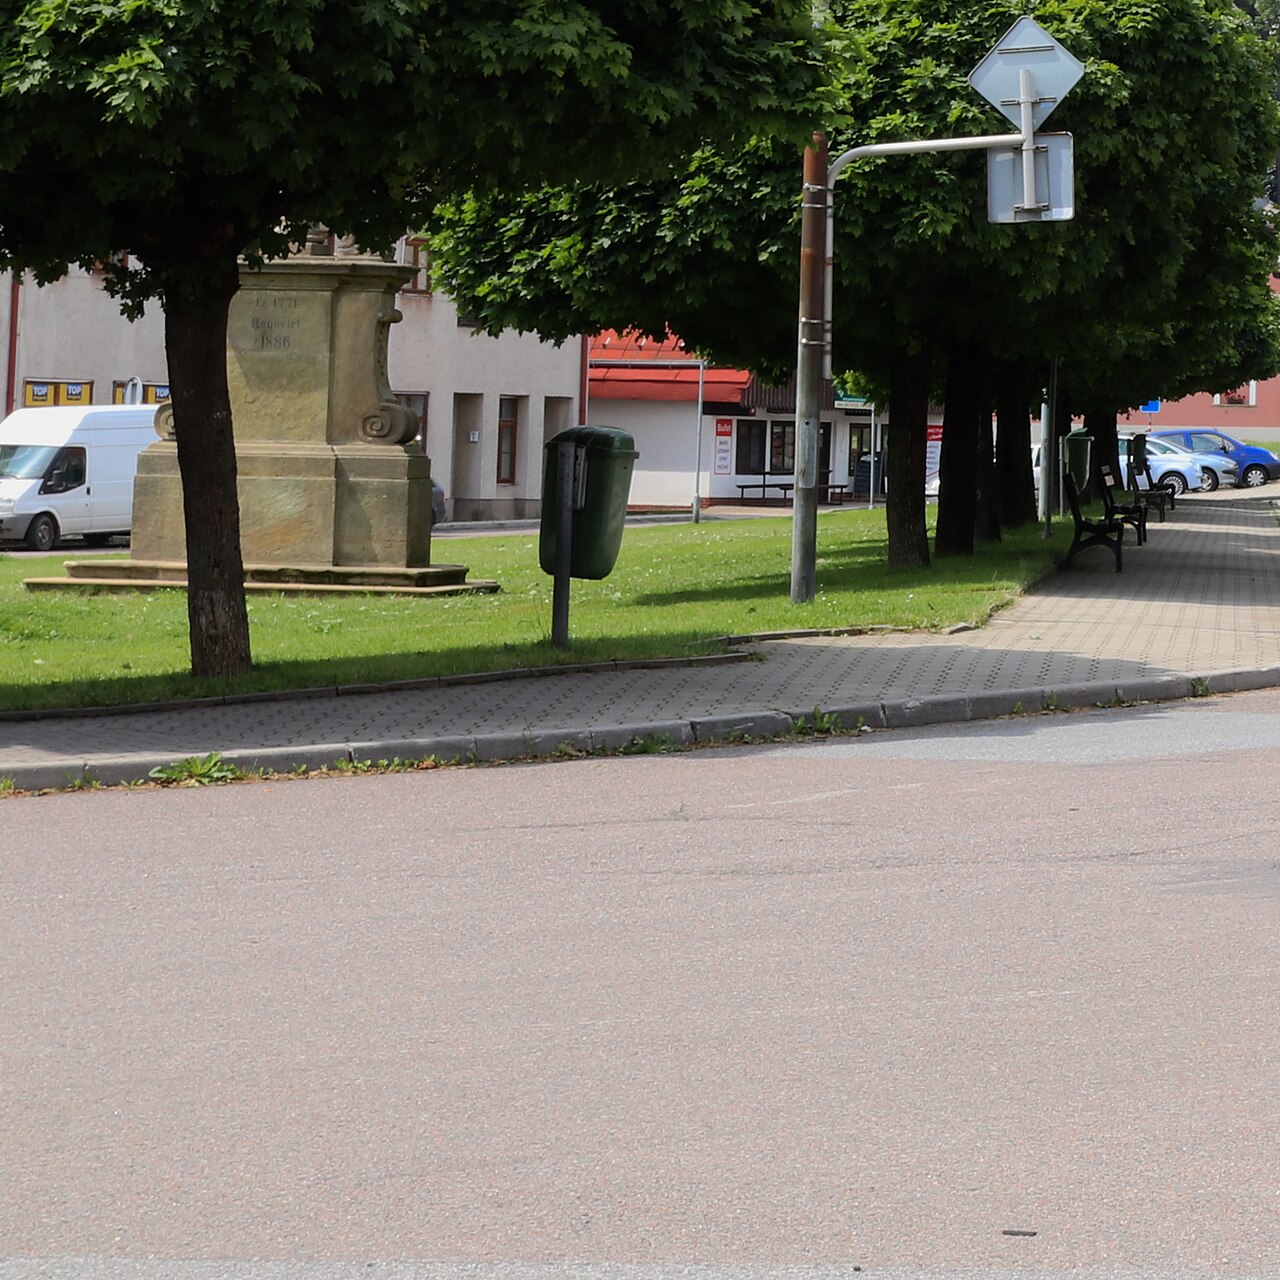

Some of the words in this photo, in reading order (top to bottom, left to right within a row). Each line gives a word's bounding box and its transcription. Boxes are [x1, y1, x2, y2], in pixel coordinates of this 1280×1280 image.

[261, 335, 290, 349] 1886
[33, 386, 47, 395] TOP
[67, 385, 82, 394] TOP
[155, 387, 170, 397] TOP
